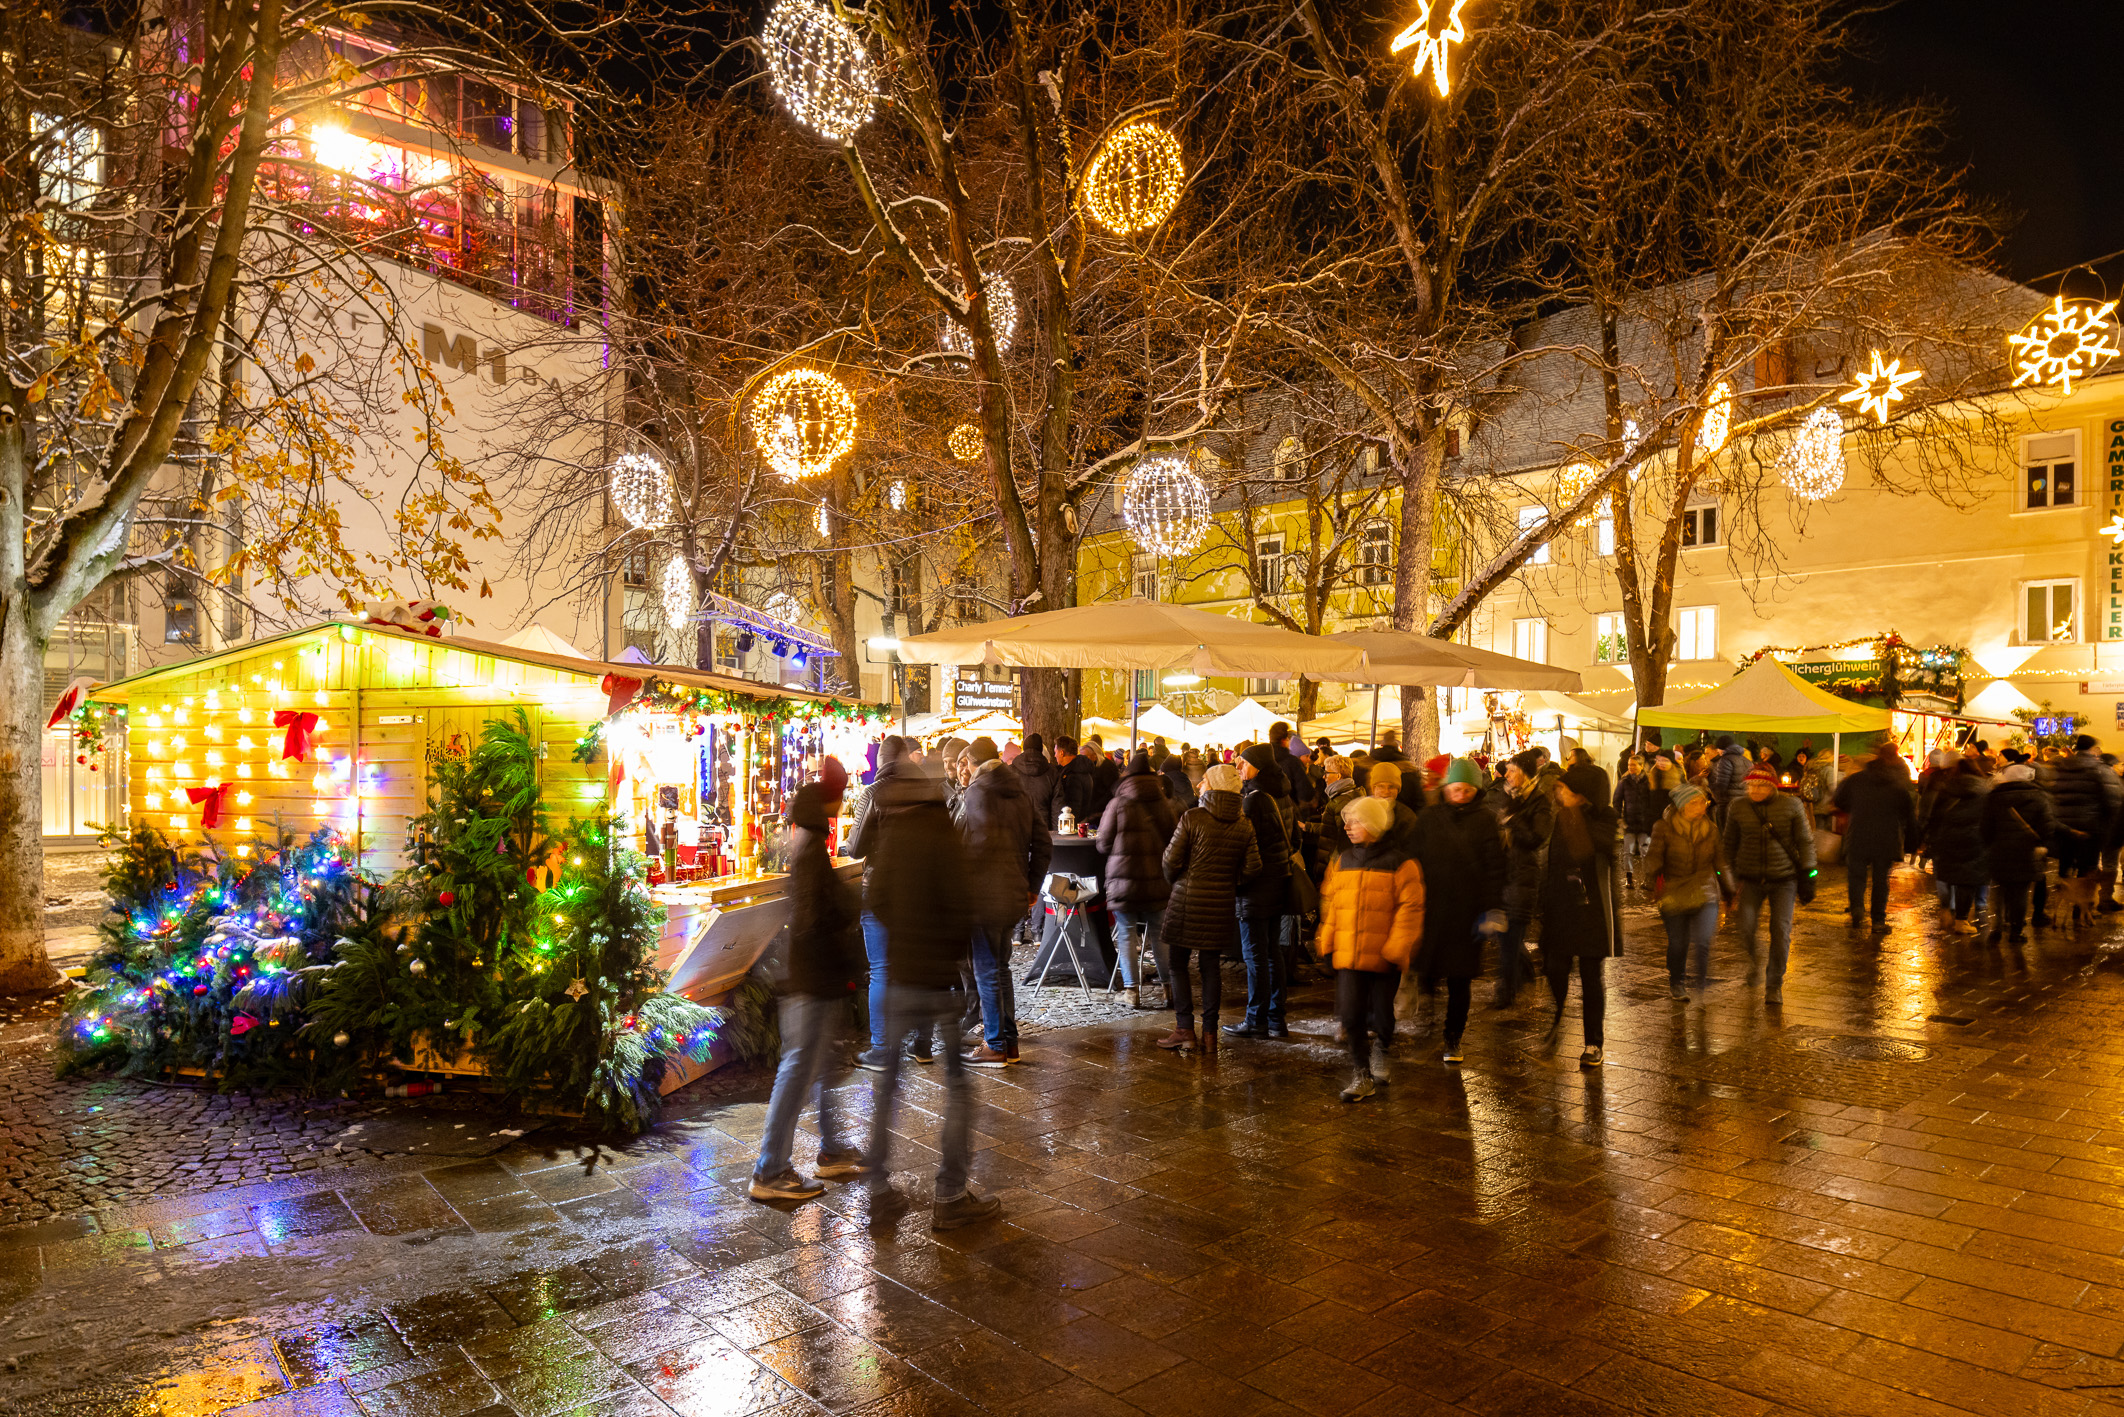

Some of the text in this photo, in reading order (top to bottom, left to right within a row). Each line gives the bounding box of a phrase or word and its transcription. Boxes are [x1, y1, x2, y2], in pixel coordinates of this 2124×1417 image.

[422, 321, 506, 386] M1
[2108, 420, 2124, 638] GAMBRINSKELLER
[956, 681, 982, 694] Charly
[956, 695, 1013, 708] Glühweinstand
